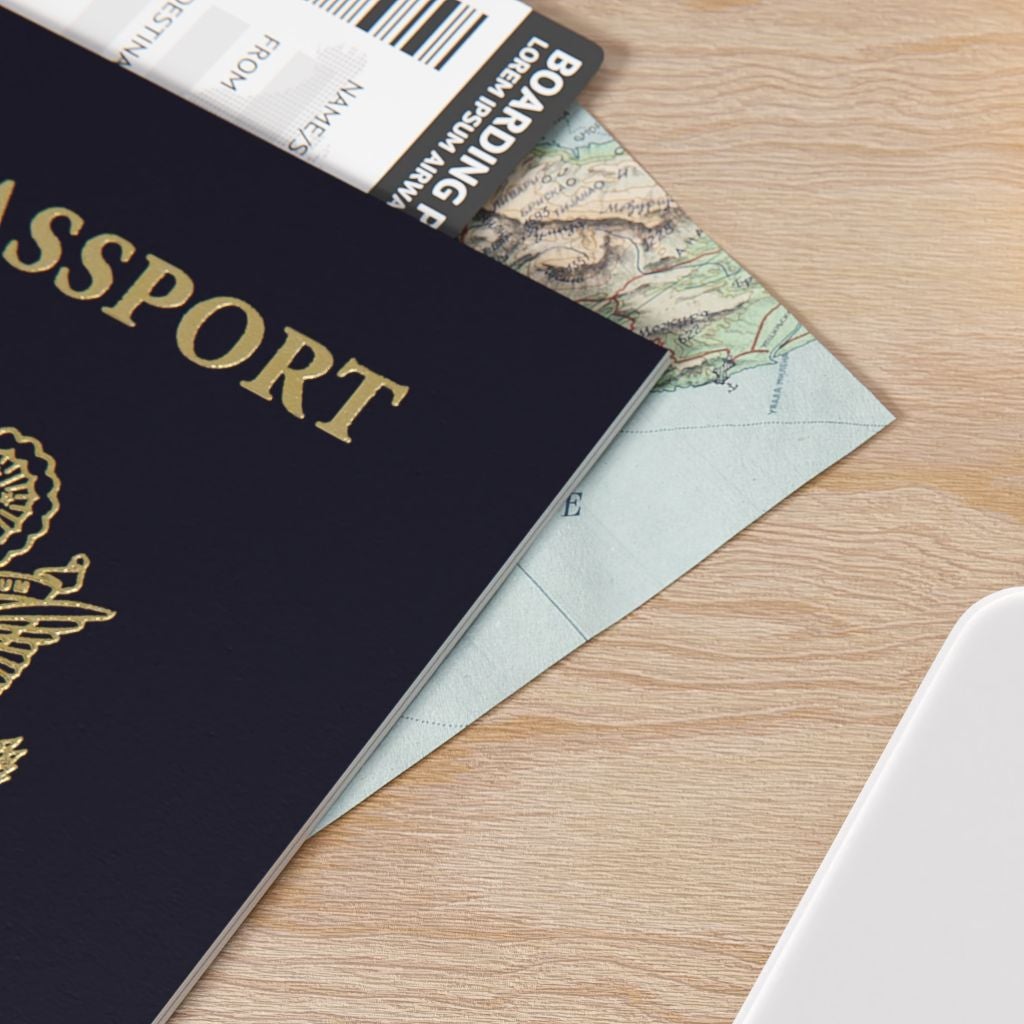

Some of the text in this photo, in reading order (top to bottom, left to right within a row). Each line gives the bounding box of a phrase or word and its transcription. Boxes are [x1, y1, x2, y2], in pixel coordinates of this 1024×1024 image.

[220, 33, 281, 92] FROM
[488, 36, 549, 101] LOREM
[287, 78, 365, 157] NAME/S
[431, 48, 584, 207] BOARDING
[437, 98, 500, 155] IPSUM
[0, 178, 411, 445] SSPORT
